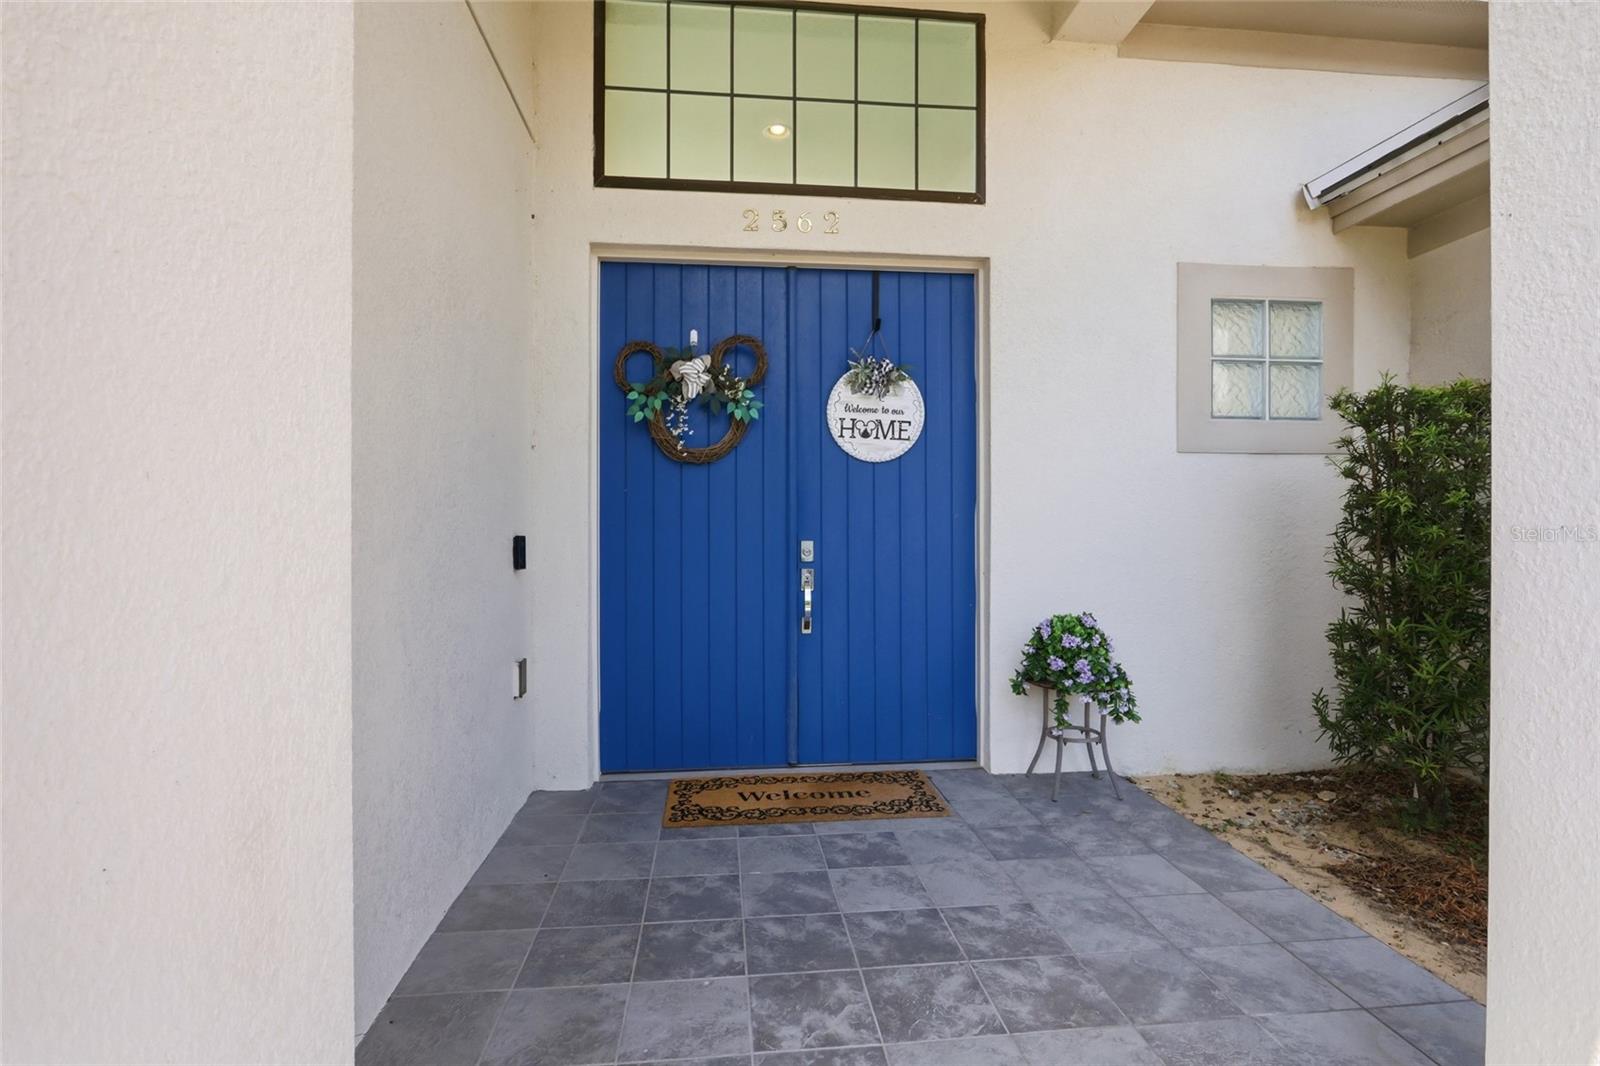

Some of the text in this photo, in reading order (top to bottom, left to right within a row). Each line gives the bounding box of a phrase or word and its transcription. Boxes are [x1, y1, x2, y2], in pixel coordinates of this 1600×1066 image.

[742, 208, 840, 234] 2562
[844, 403, 878, 413] Welcome
[881, 406, 889, 414] to
[838, 417, 911, 441] HOME
[737, 788, 872, 802] Welcome
